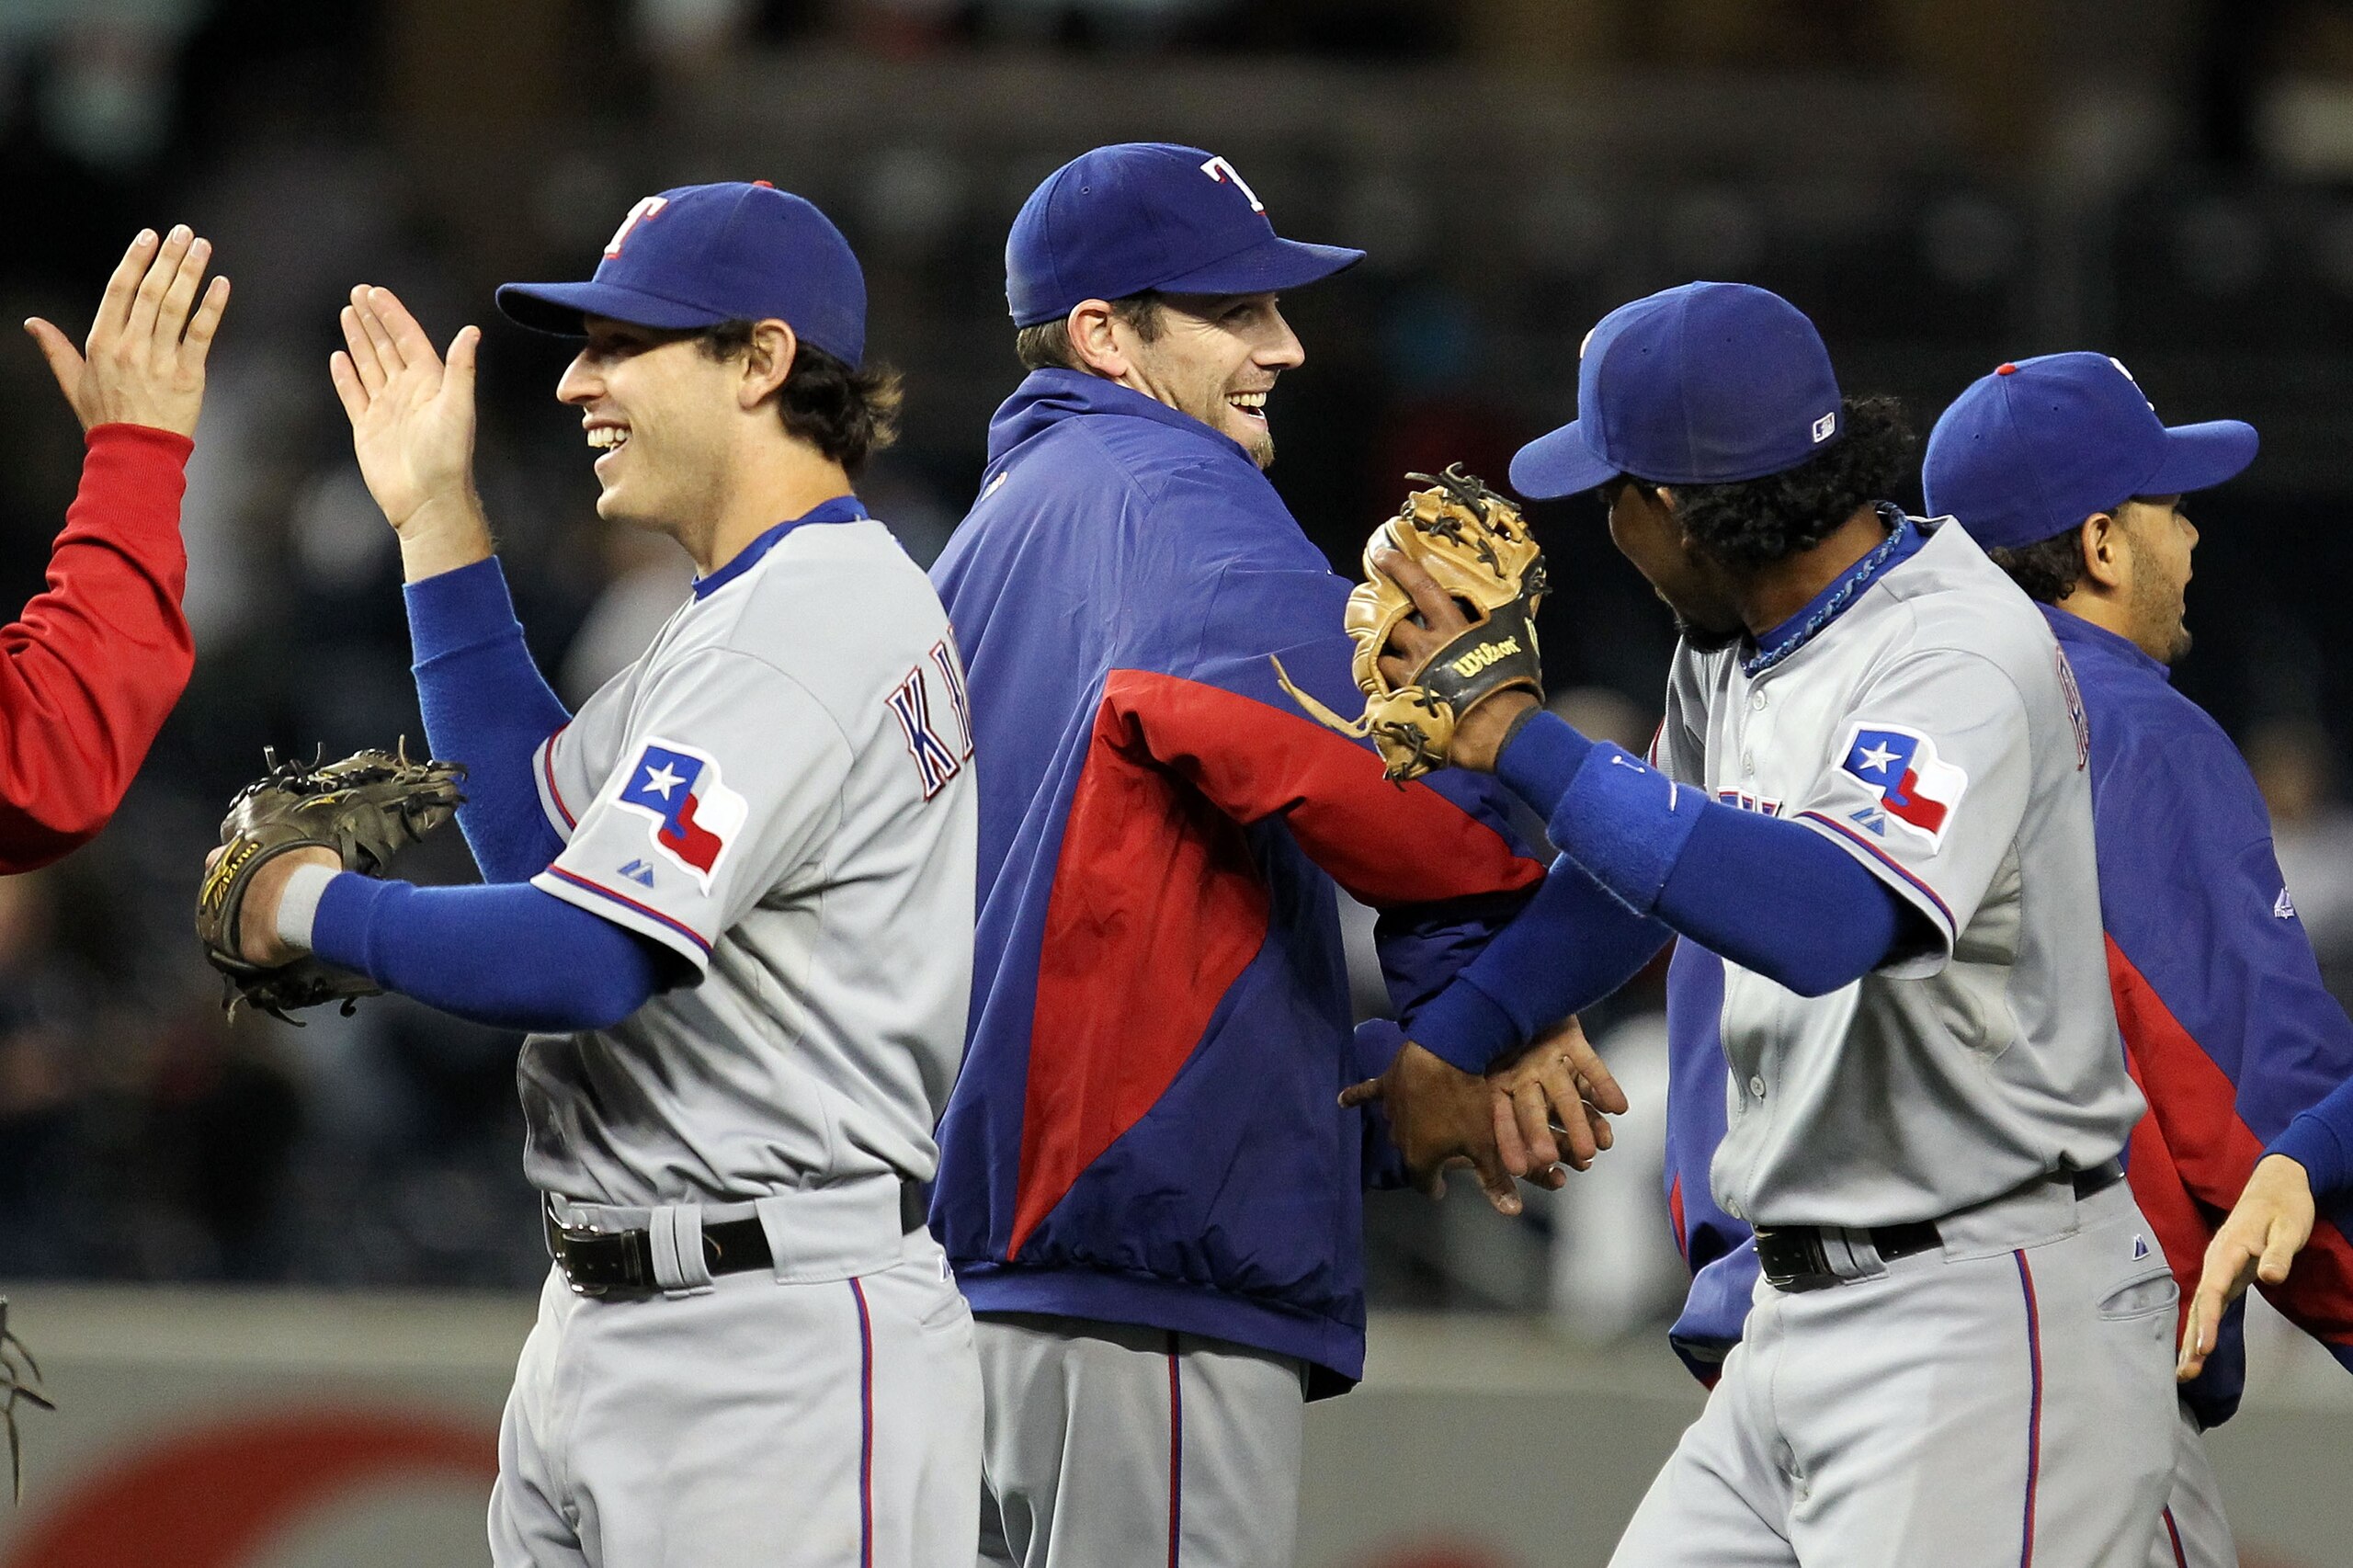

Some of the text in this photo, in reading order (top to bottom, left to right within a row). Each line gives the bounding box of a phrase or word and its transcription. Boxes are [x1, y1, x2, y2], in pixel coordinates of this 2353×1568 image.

[1199, 155, 1265, 215] T
[604, 196, 669, 259] T
[1452, 635, 1522, 677] Wilson
[884, 625, 974, 802] KI
